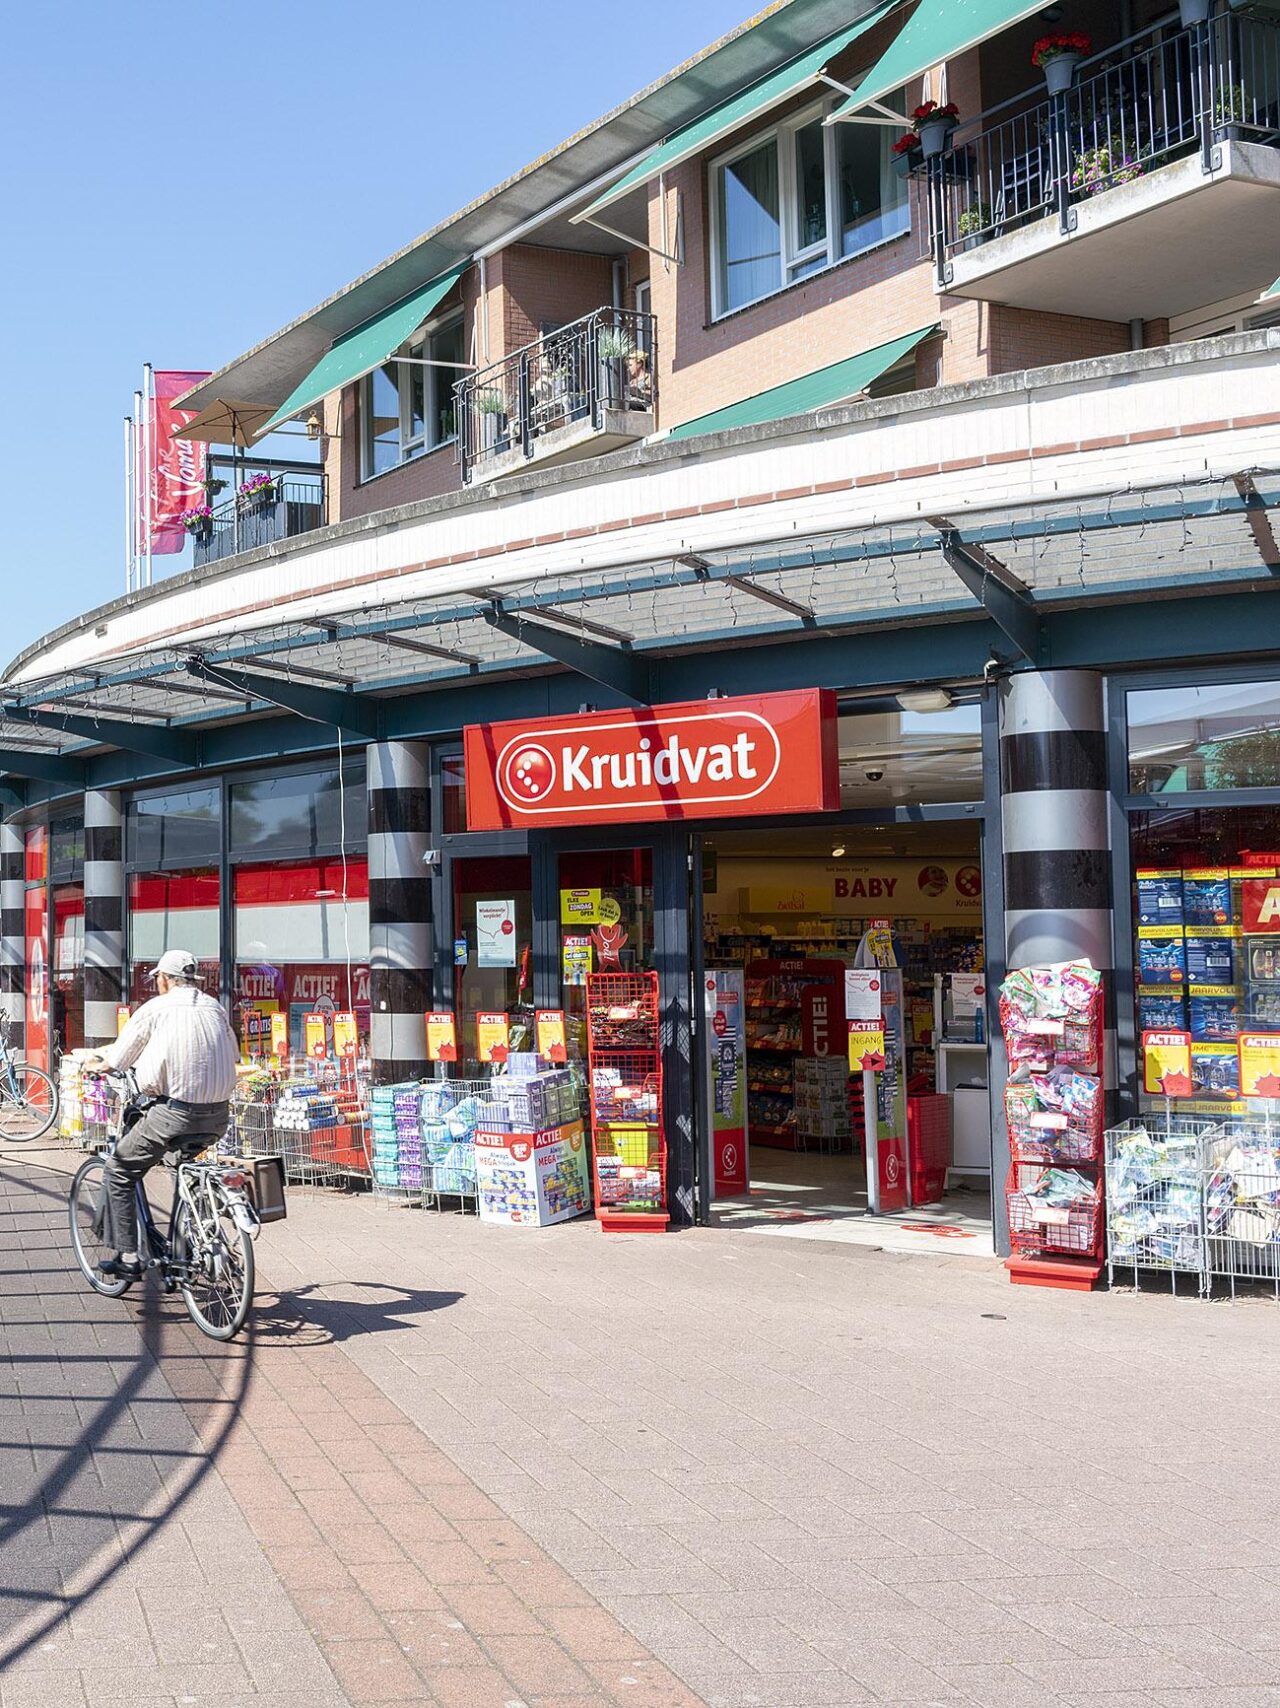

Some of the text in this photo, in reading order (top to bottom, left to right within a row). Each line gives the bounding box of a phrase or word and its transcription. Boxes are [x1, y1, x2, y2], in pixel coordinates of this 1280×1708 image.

[561, 732, 758, 792] Kruidvat
[834, 877, 898, 898] BABY
[565, 937, 588, 946] ACTIE!
[779, 961, 804, 970] ACTIE!
[293, 974, 339, 999] ACTIE!
[812, 996, 829, 1057] CTIE!
[851, 1023, 880, 1031] ACTIE!
[851, 1036, 882, 1045] INGANG
[1147, 1033, 1186, 1046] ACTIE!
[476, 1133, 504, 1146] ACTIE!
[535, 1128, 562, 1147] ACTIE!
[538, 1155, 557, 1167] MEGA
